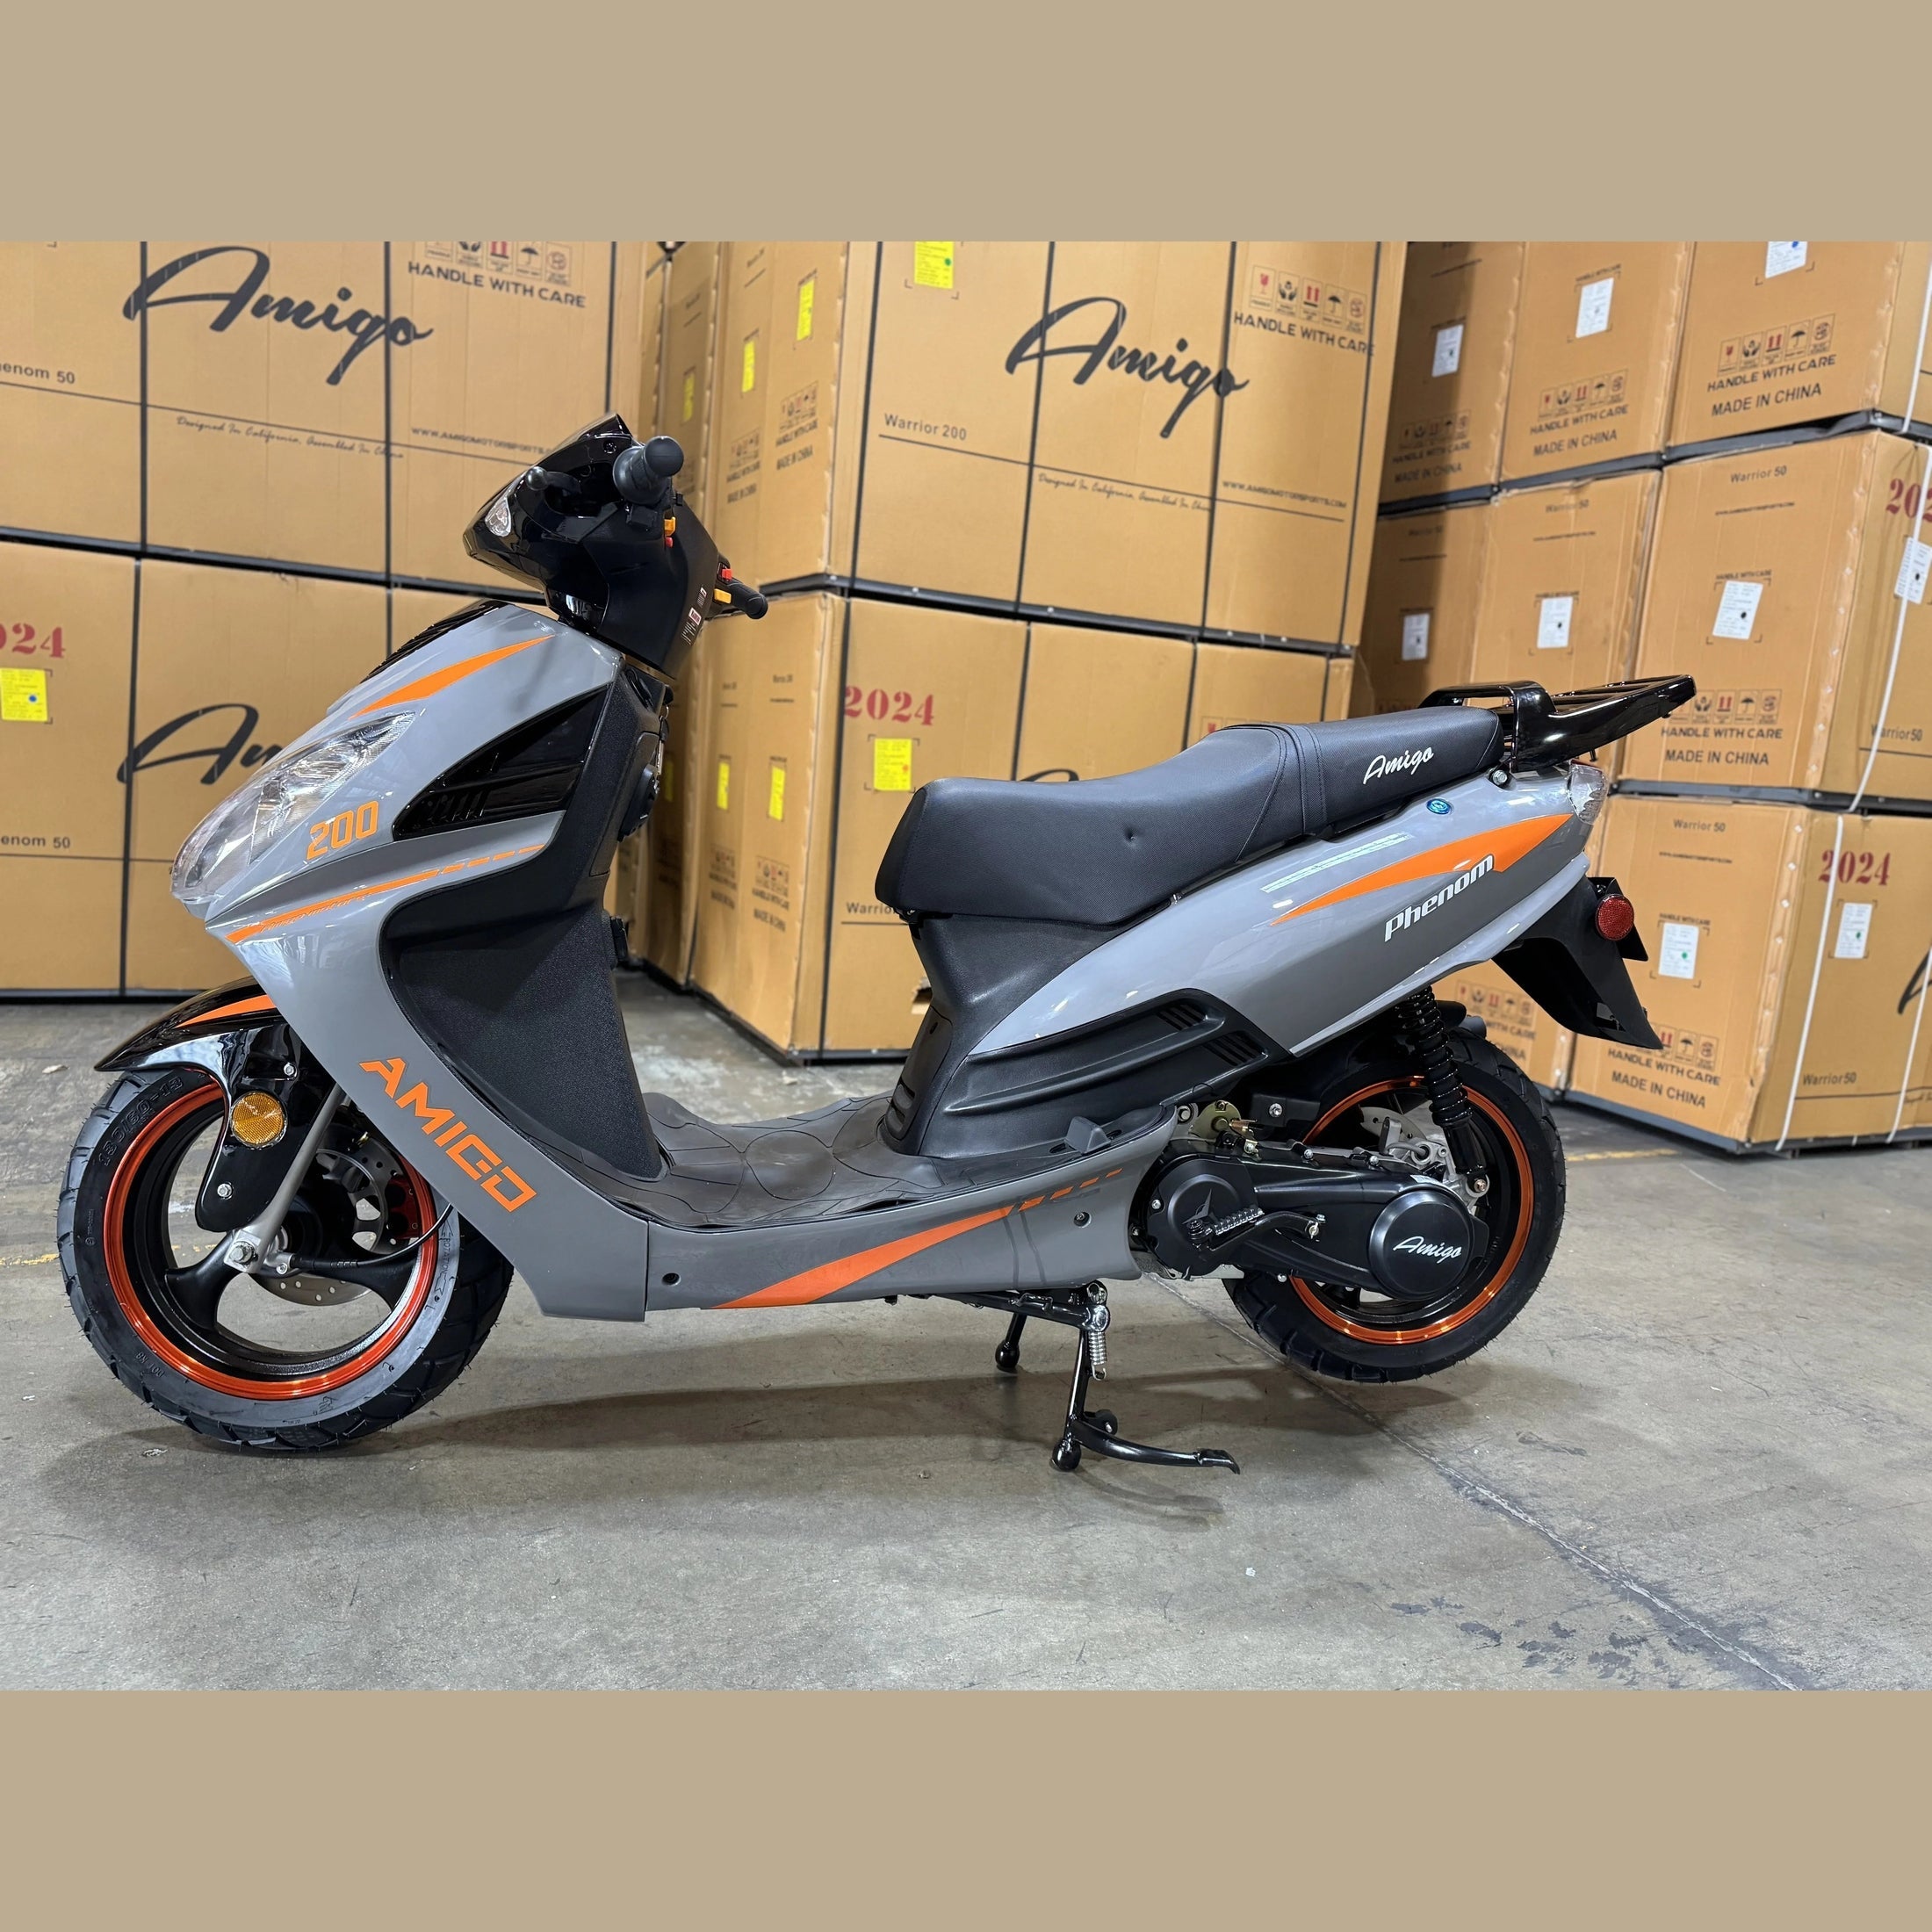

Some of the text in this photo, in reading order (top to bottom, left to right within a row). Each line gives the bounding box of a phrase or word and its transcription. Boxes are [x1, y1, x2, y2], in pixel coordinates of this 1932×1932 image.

[407, 261, 485, 288] HANDLE
[489, 277, 535, 299] WITH
[537, 287, 587, 308] CARE
[122, 245, 434, 386] Amigo
[1233, 311, 1297, 338] HANDLE
[1300, 326, 1336, 347] WITH
[56, 371, 76, 385] 50
[1005, 296, 1250, 439] Amigo
[1706, 354, 1837, 393] HANDLE WITH CARE
[1712, 382, 1822, 417] MADE IN CHINA
[883, 413, 967, 441] Warrior 200
[1530, 404, 1629, 436] HANDLE WITH CARE
[1532, 429, 1618, 456] MADE IN CHINA
[1730, 465, 1788, 483] Warrior 50
[0, 622, 67, 659] 24
[843, 684, 935, 727] 2024
[1660, 726, 1784, 739] HANDLE WITH CARE
[1910, 728, 1923, 742] 50
[1362, 746, 1435, 785] Amigo
[1664, 749, 1770, 766] MADE IN CHINA
[53, 836, 71, 850] 50
[306, 800, 379, 861] 200
[1673, 818, 1727, 833] Warrior 50
[1817, 849, 1891, 887] 2024
[846, 901, 896, 915] Warrio
[1607, 1047, 1721, 1086] HANDLE WITH CARE
[1802, 1071, 1857, 1086] Warrior 50
[1611, 1070, 1706, 1109] MADE IN CHINA
[358, 1056, 538, 1214] AMIGO
[1392, 1236, 1462, 1265] Amigo
